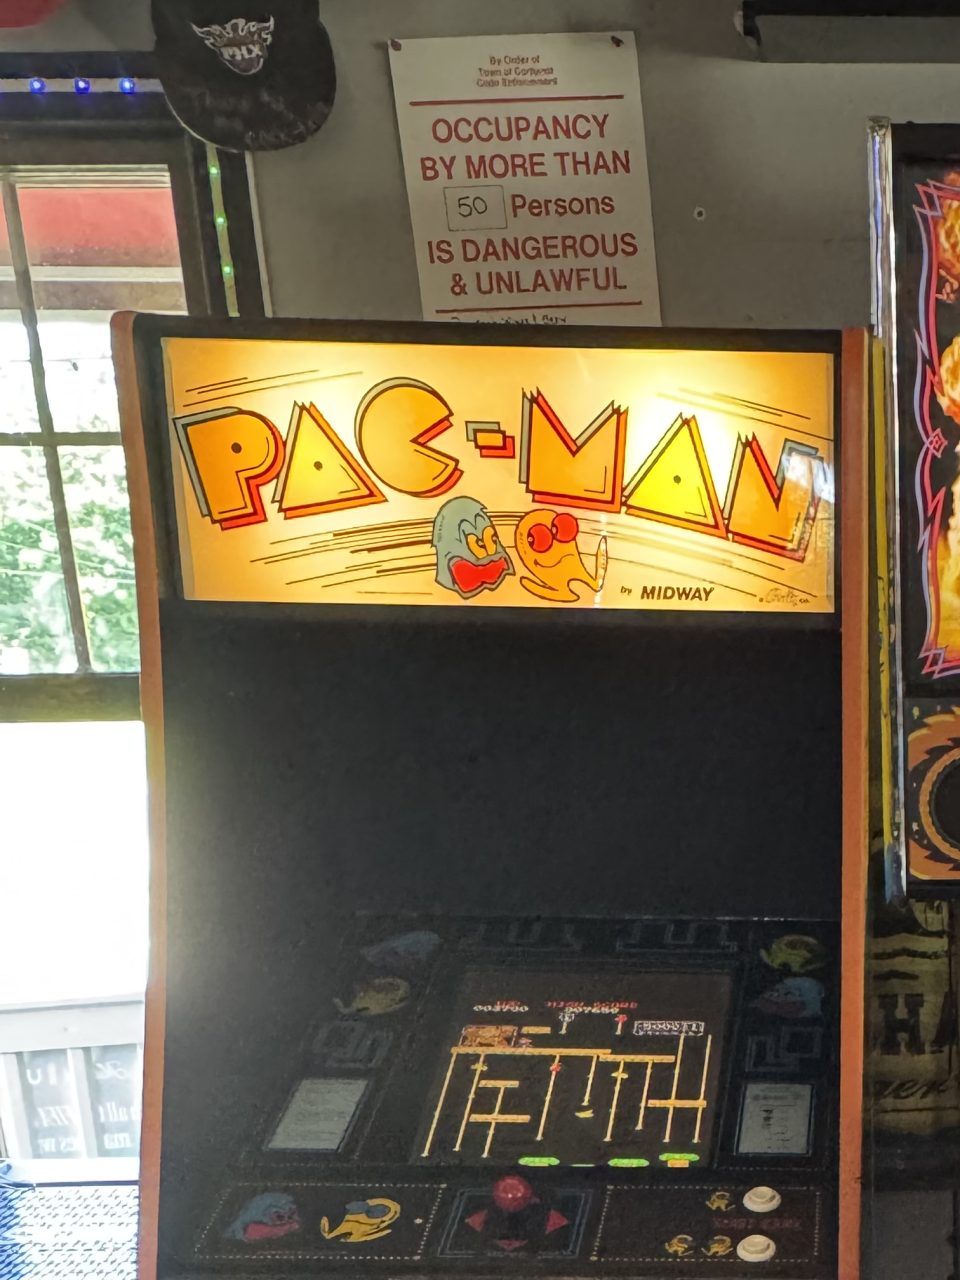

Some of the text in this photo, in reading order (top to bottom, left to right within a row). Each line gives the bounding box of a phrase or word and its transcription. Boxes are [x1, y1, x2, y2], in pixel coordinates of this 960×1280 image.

[432, 114, 609, 144] OCCUPANCY
[420, 150, 631, 182] BY MORE THAN
[457, 194, 616, 218] 50 Persons
[427, 233, 639, 264] IS DANGEROUS
[450, 267, 627, 296] & UNLAWFUL
[174, 376, 826, 562] PAC-MAN
[620, 585, 714, 601] by MIDWAY
